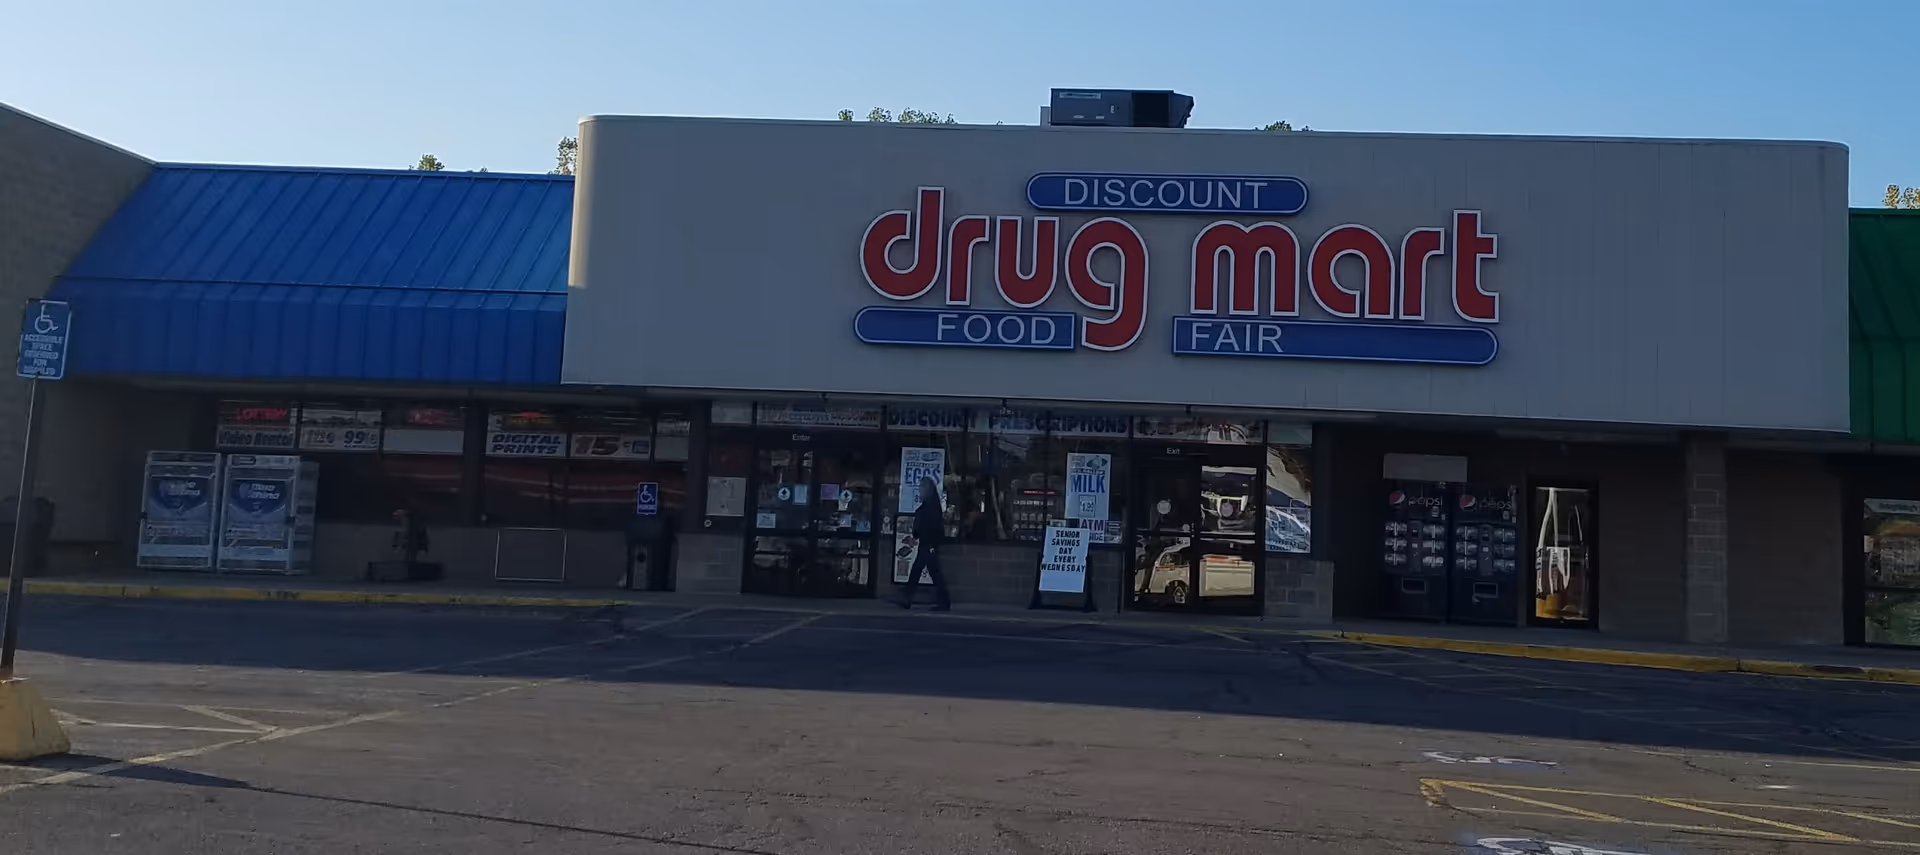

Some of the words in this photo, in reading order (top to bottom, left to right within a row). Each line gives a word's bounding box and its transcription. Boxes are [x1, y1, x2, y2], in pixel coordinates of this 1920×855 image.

[1064, 178, 1268, 209] DISCOUNT
[859, 186, 1150, 351] drug
[1190, 209, 1499, 323] mart
[936, 313, 1056, 344] FOOD
[1191, 322, 1284, 353] FAIR
[493, 434, 561, 445] DIGITAL
[492, 444, 559, 455] PRINTS
[1166, 447, 1180, 455] Exit
[1071, 474, 1106, 494] MILK
[1080, 519, 1104, 531] ATM
[1056, 530, 1080, 538] SENIOR
[1051, 539, 1080, 547] SAVINGS
[1059, 547, 1073, 555] DAY
[1054, 555, 1077, 563] EVERY
[1041, 563, 1085, 573] WEDNESDAY
